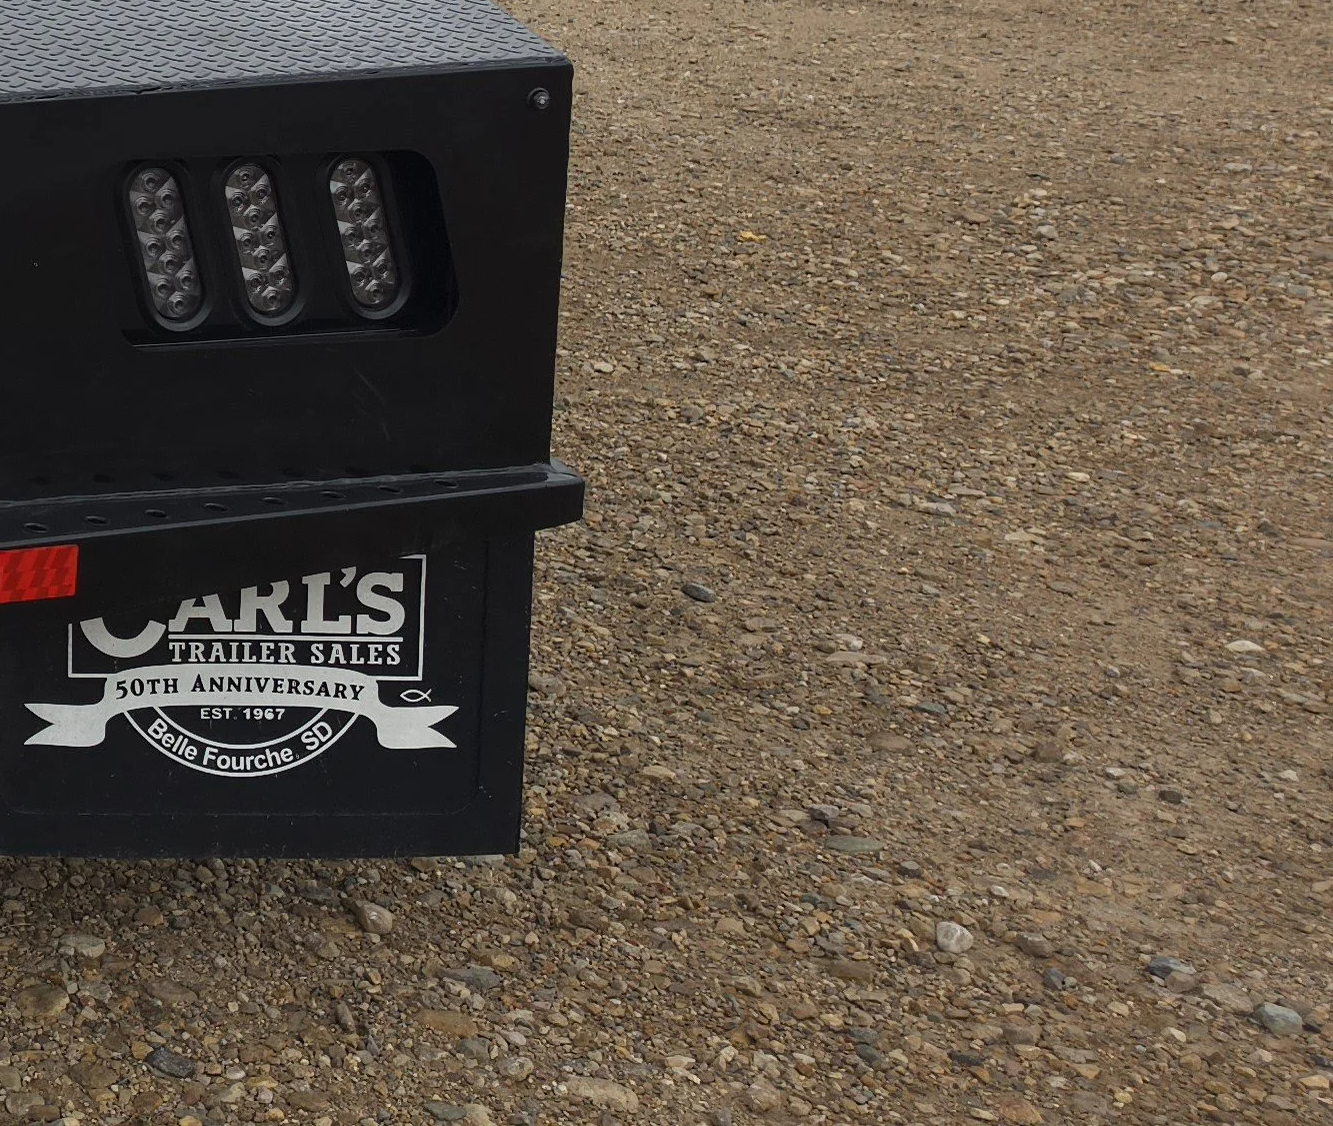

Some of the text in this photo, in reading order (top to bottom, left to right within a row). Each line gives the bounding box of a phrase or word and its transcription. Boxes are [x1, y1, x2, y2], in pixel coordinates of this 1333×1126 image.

[168, 642, 402, 665] TRAILER SALES
[115, 673, 365, 701] 50TH ANNIVERSARY
[242, 708, 286, 720] 1967
[147, 718, 198, 761] Belle
[300, 721, 333, 751] SD
